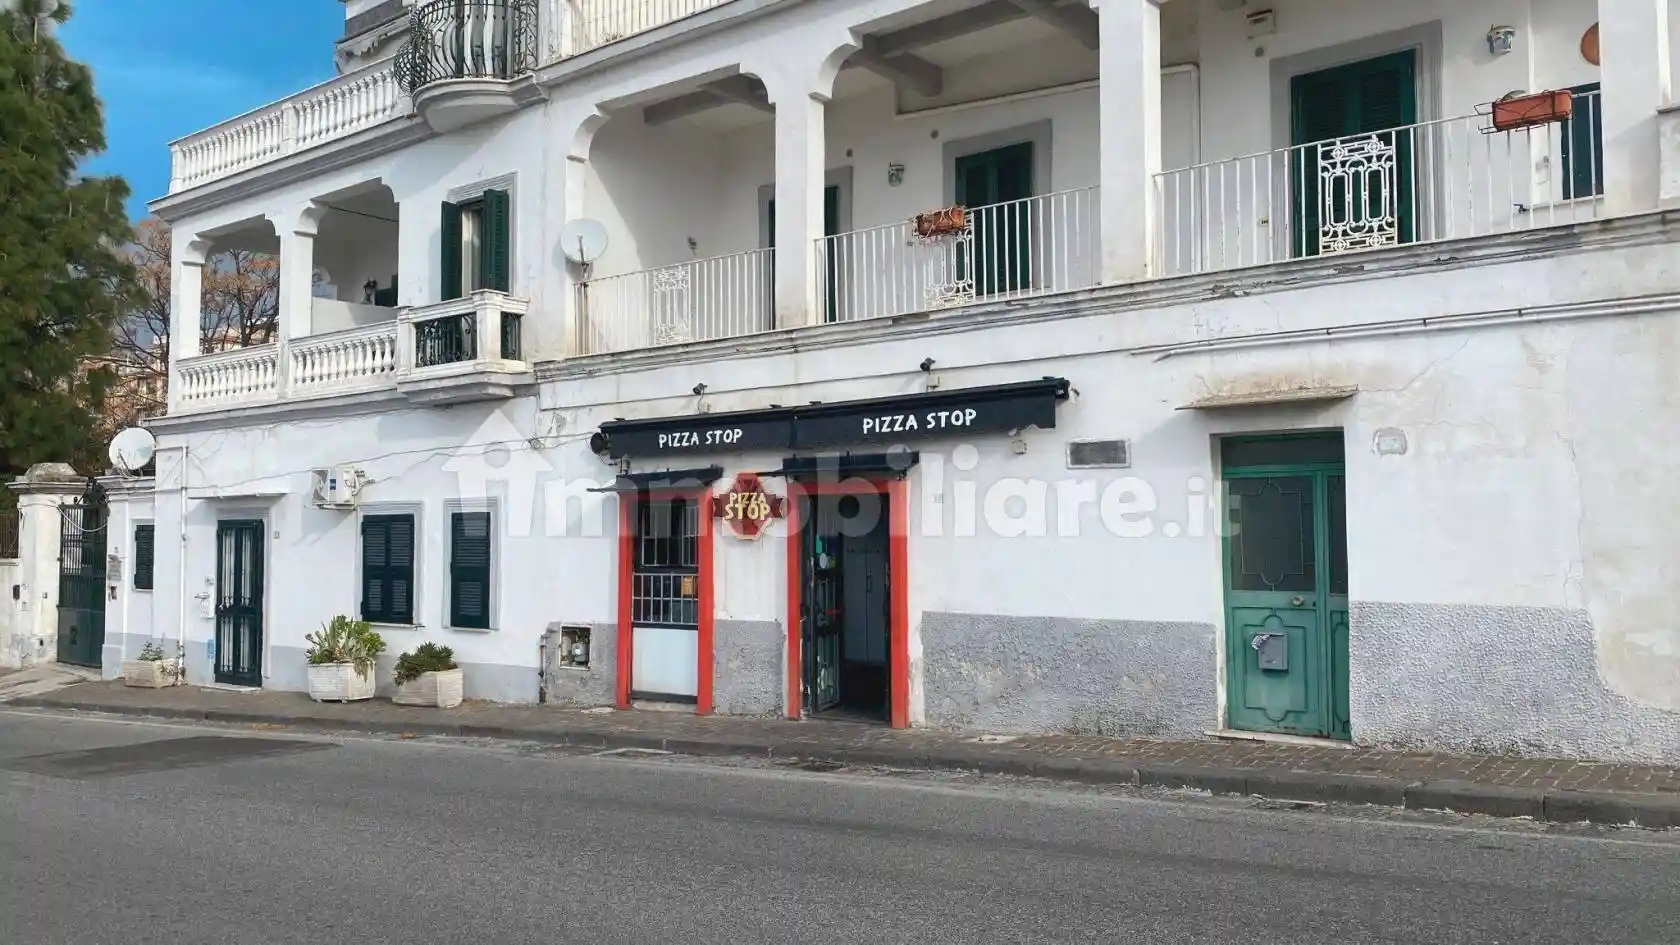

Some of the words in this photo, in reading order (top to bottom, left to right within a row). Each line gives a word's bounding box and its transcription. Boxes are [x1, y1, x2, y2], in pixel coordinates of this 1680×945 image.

[863, 414, 918, 434] PIZZA
[926, 408, 977, 429] STOP
[659, 432, 699, 448] PIZZA
[705, 429, 742, 444] STOP
[729, 492, 767, 505] PIZZA
[725, 502, 771, 520] STOP
